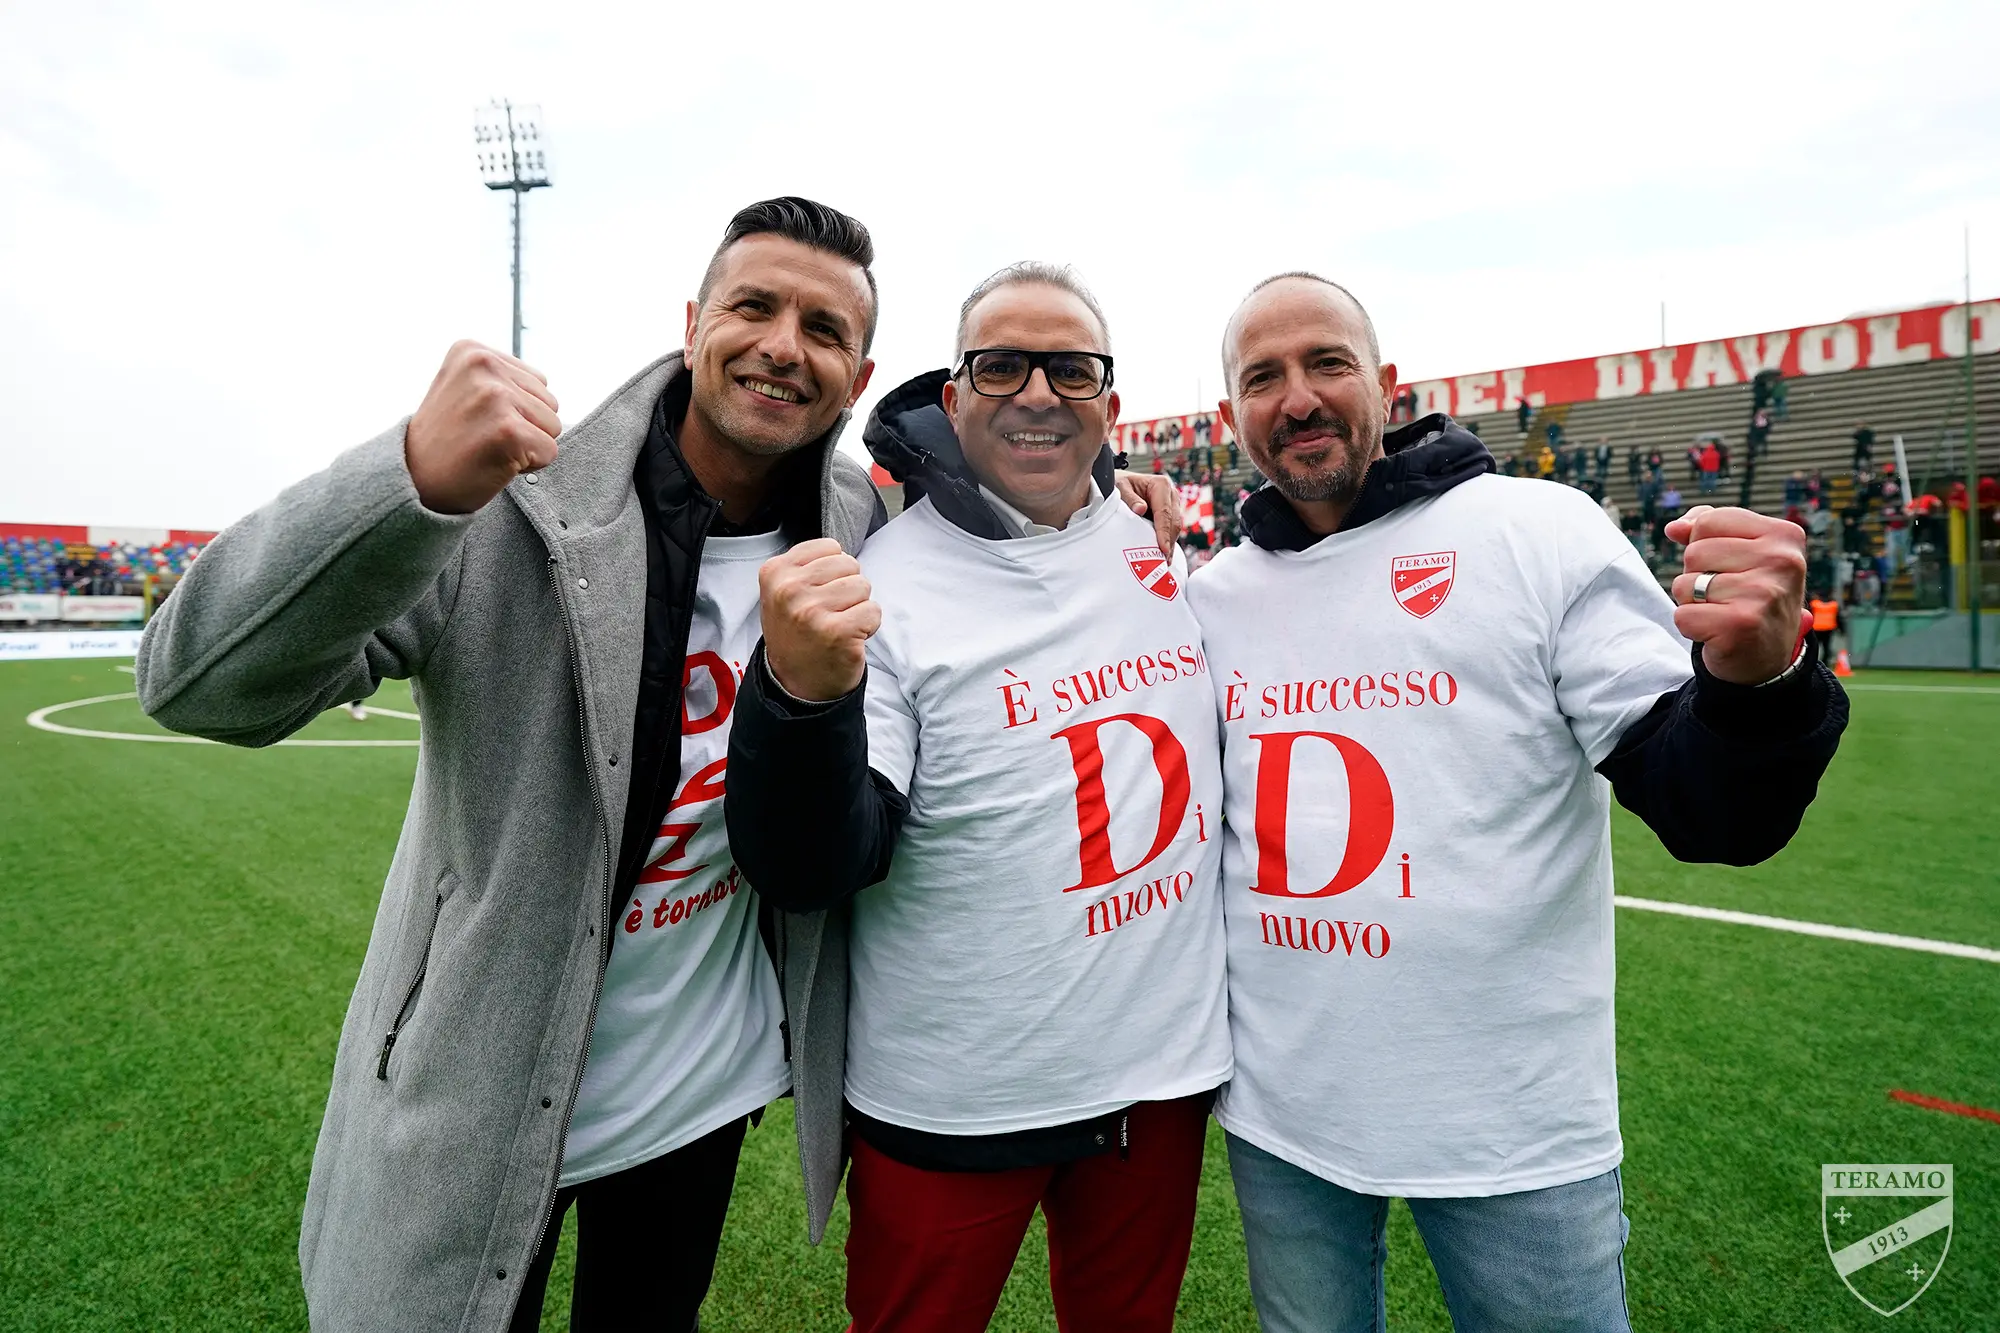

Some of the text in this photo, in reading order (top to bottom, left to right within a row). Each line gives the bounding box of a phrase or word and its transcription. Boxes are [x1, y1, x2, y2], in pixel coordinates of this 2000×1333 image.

[1411, 367, 1546, 419] DEL
[1595, 300, 2000, 400] DIAVOLO
[1398, 556, 1450, 568] TERAMO
[1413, 580, 1432, 593] 1913
[997, 645, 1205, 729] È successo
[1224, 670, 1458, 723] È successo
[1248, 731, 1416, 899] Di
[624, 865, 743, 934] è tornat
[1085, 870, 1193, 937] nuovo
[1259, 911, 1391, 959] nuovo
